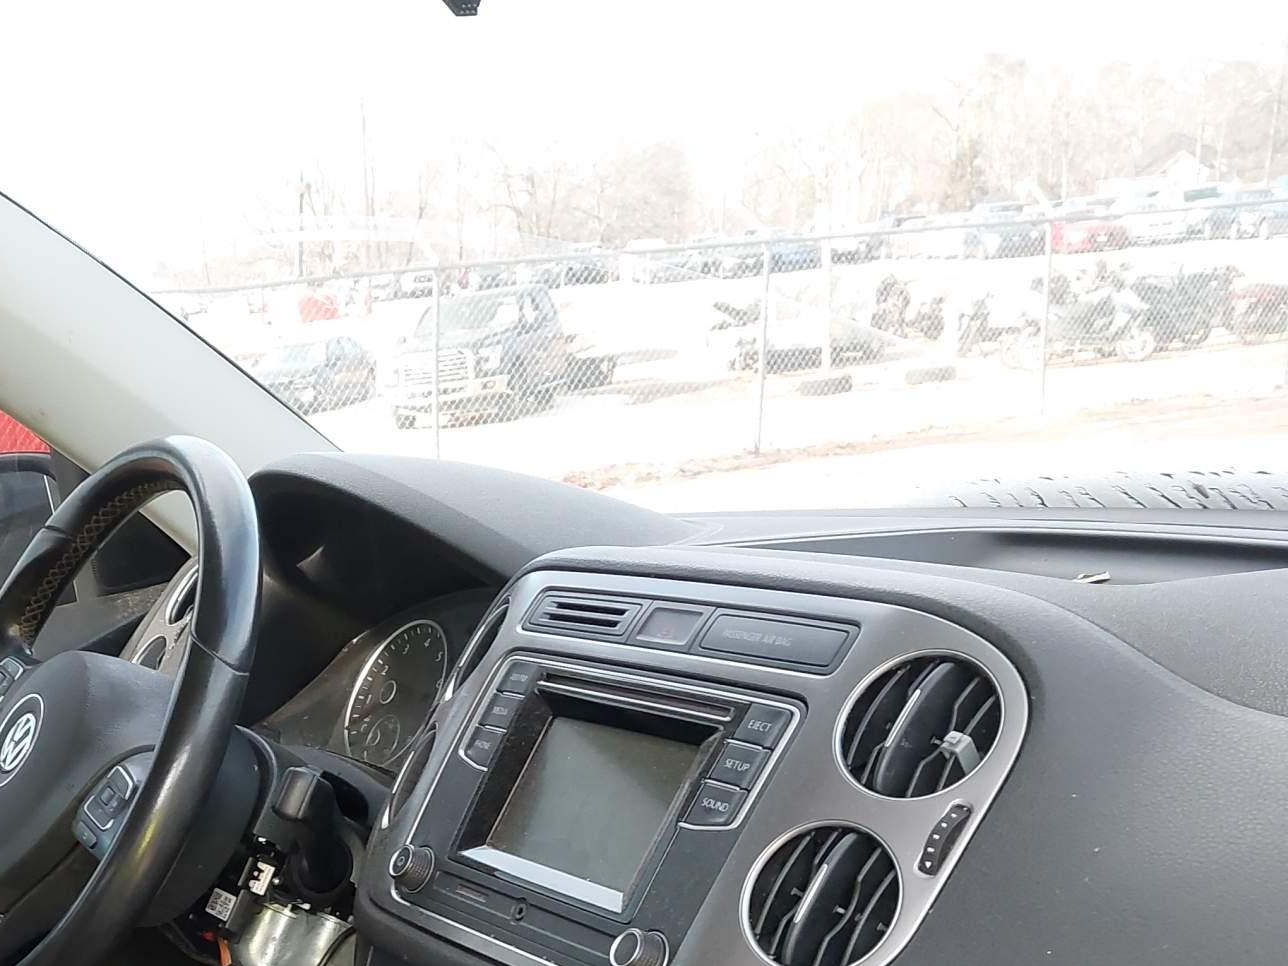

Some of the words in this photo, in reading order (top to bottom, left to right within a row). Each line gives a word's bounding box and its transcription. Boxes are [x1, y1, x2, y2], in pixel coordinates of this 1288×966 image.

[747, 719, 773, 732] EJECT
[724, 758, 750, 772] SETUP
[701, 797, 729, 812] SOUND
